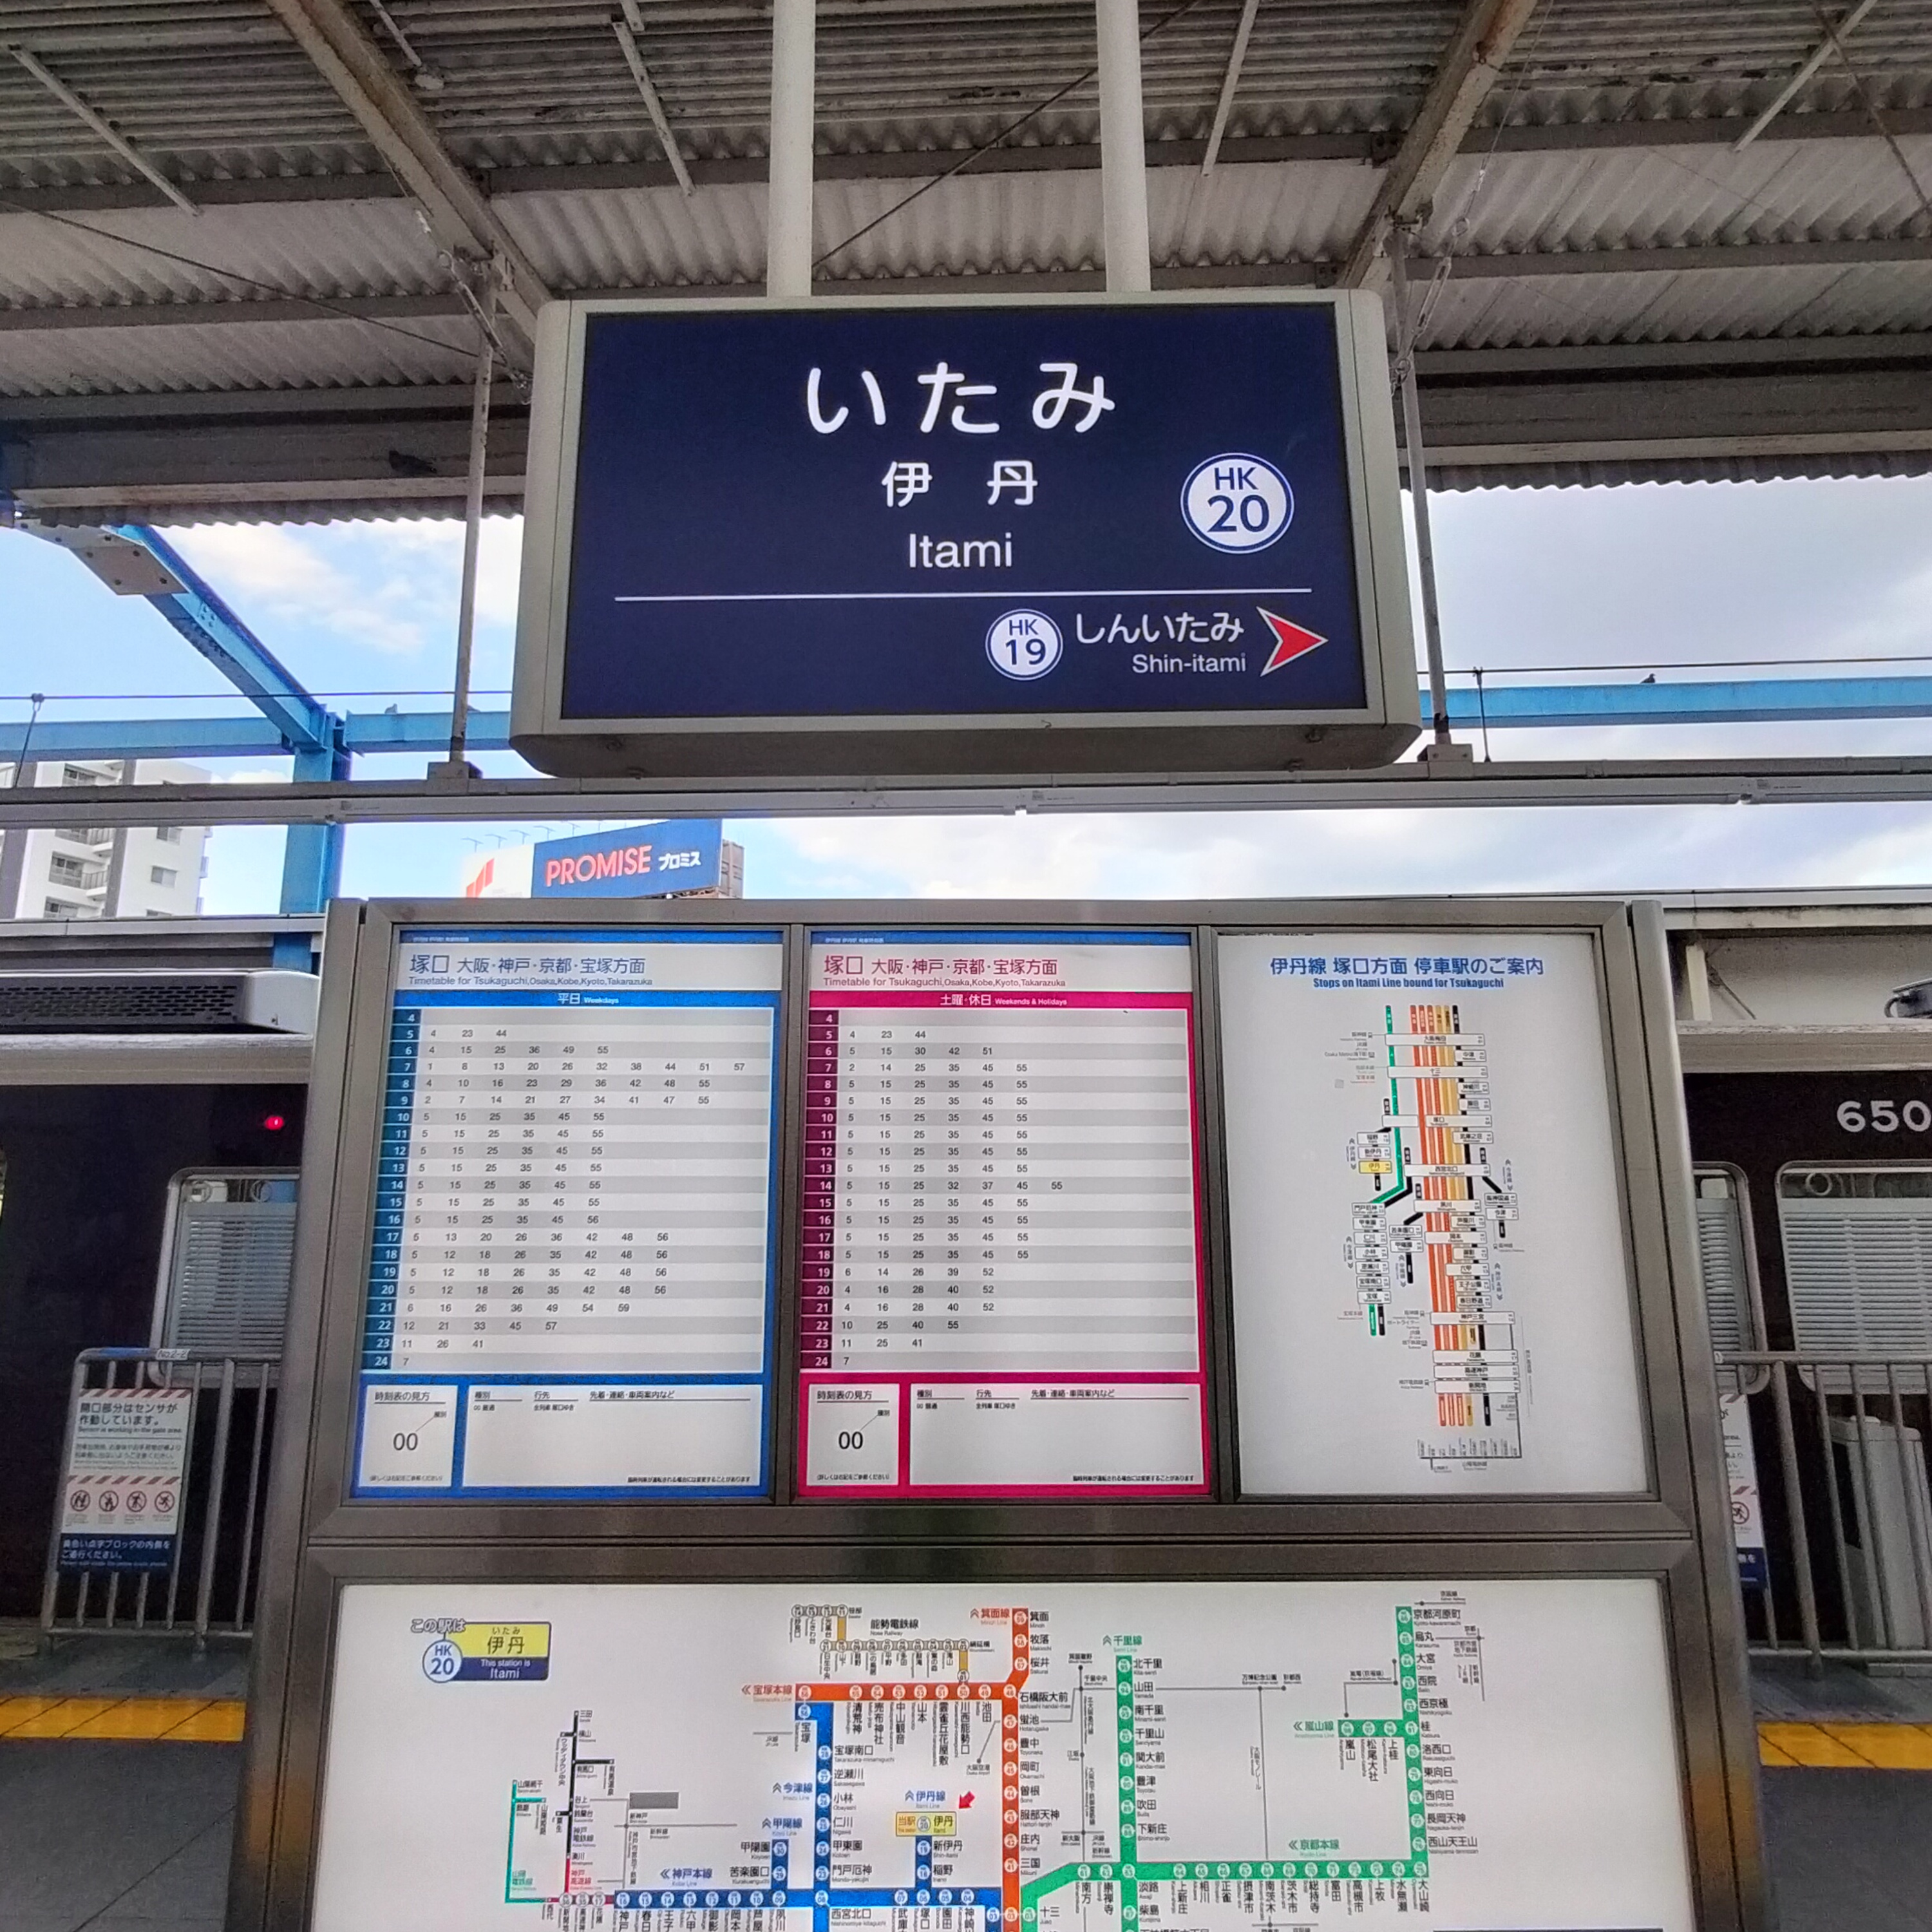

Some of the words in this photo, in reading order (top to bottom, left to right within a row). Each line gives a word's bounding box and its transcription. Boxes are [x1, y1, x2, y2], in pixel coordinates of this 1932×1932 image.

[808, 362, 1115, 433] いたみ
[1215, 468, 1257, 490] HK
[1208, 495, 1269, 532] 20
[910, 533, 1011, 567] Itami
[1009, 619, 1038, 636] HK
[1077, 612, 1244, 643] しんいたみ
[1006, 639, 1045, 665] 19
[1133, 654, 1245, 673] Shin-itami
[546, 844, 653, 887] PROMISE
[658, 851, 701, 871] プロミス
[410, 954, 449, 974] 塚口
[824, 955, 862, 975] 塚口
[1271, 958, 1326, 974] 伊丹線
[1333, 958, 1407, 974] 塚口方面
[1414, 958, 1543, 974] 停車駅のご案内
[408, 976, 455, 985] Timetable
[822, 978, 870, 986] Timetable
[873, 978, 886, 986] for
[1314, 978, 1340, 988] Stops
[1356, 978, 1380, 987] Itami
[1383, 978, 1401, 987] Line
[1403, 978, 1433, 987] bound
[1435, 978, 1448, 987] for
[1450, 978, 1503, 989] Tsukaguchi
[557, 992, 580, 1005] 平日
[1037, 998, 1067, 1007] Holidays
[406, 1046, 412, 1055] 6
[826, 1047, 831, 1056] 6
[816, 1339, 828, 1348] 23
[877, 1339, 888, 1347] 25
[815, 1357, 828, 1366] 24
[374, 1392, 430, 1401] 時刻表の見方
[817, 1390, 872, 1400] 時刻表の見方
[917, 1389, 933, 1397] 種別
[976, 1389, 992, 1397] 行先
[80, 1403, 178, 1414] 開口部分はセンサが
[79, 1415, 158, 1426] 作動しています。
[393, 1432, 419, 1451] 00
[838, 1431, 864, 1450] 00
[1414, 1609, 1461, 1619] 京都河原町
[411, 1618, 466, 1634] この駅は
[1030, 1634, 1048, 1644] 牧落
[488, 1636, 525, 1654] 伊丹
[435, 1645, 452, 1656] HK
[1030, 1658, 1049, 1667] 桜井
[1417, 1653, 1435, 1663] 大宮
[430, 1658, 455, 1675] 20
[1134, 1658, 1162, 1669] 北千里
[490, 1669, 520, 1679] Itami
[1134, 1681, 1153, 1692] 山田
[1020, 1692, 1067, 1702] 石橋阪大前
[918, 1702, 927, 1723] 山本
[982, 1701, 991, 1722] 池田
[1135, 1705, 1163, 1715] 南千里
[1135, 1728, 1164, 1738] 千里山
[1021, 1738, 1039, 1748] 豊中
[835, 1745, 873, 1755] 宝塚南口
[1423, 1744, 1451, 1754] 洛西口
[1136, 1752, 1164, 1762] 関大前
[1020, 1761, 1039, 1772] 岡町
[835, 1769, 863, 1779] 逆瀬川
[1425, 1767, 1452, 1777] 東向日
[1137, 1776, 1155, 1786] 豊津
[784, 1783, 812, 1793] 今津線
[834, 1793, 853, 1803] 小林
[916, 1791, 945, 1801] 伊丹線
[1425, 1790, 1454, 1800] 西向日
[1137, 1800, 1156, 1810] 吹田
[1021, 1810, 1059, 1820] 服部天神
[833, 1817, 853, 1828] 仁川
[934, 1815, 952, 1826] 伊丹
[1138, 1824, 1166, 1834] 下新庄
[1021, 1834, 1039, 1844] 庄内
[1428, 1837, 1477, 1847] 西山天王山
[741, 1842, 770, 1852] 甲陽園
[833, 1841, 862, 1850] 甲東園
[934, 1841, 962, 1851] 新伊丹
[1021, 1858, 1040, 1868] 三国
[673, 1868, 712, 1879] 神戸本線
[833, 1864, 872, 1875] 門戸厄神
[933, 1865, 952, 1875] 稲野
[831, 1908, 871, 1919] 西宮北口
[1040, 1906, 1059, 1917] 十三
